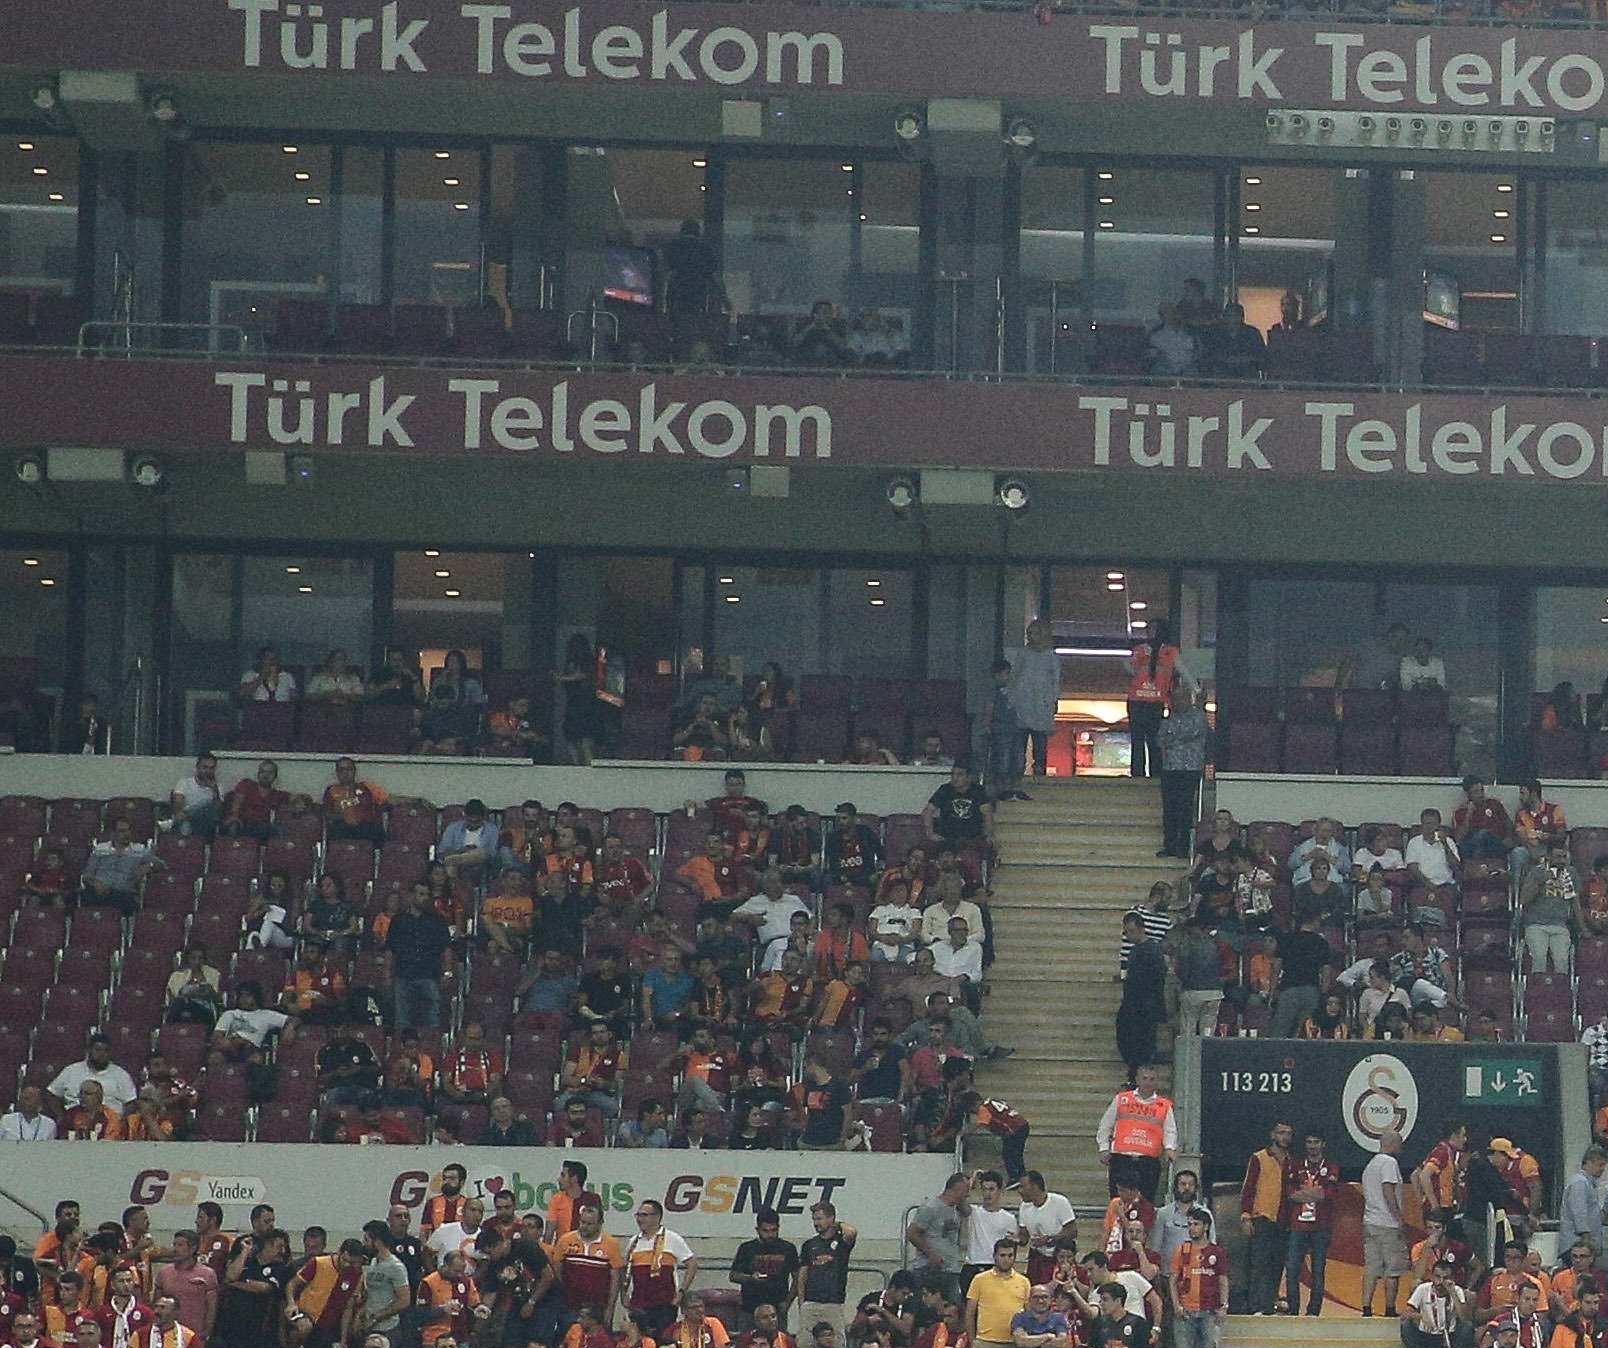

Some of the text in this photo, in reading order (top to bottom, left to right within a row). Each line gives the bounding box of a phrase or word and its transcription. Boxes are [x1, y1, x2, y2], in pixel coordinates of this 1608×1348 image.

[228, 0, 843, 84] Türk Telekom
[1090, 25, 1284, 99] Türk
[215, 373, 831, 457] Türk Telekom
[1079, 397, 1274, 469] Türk
[1220, 1071, 1293, 1094] 113 213
[129, 1169, 254, 1205] GS Yandex
[513, 1172, 633, 1211] bous
[664, 1175, 845, 1214] GSNET
